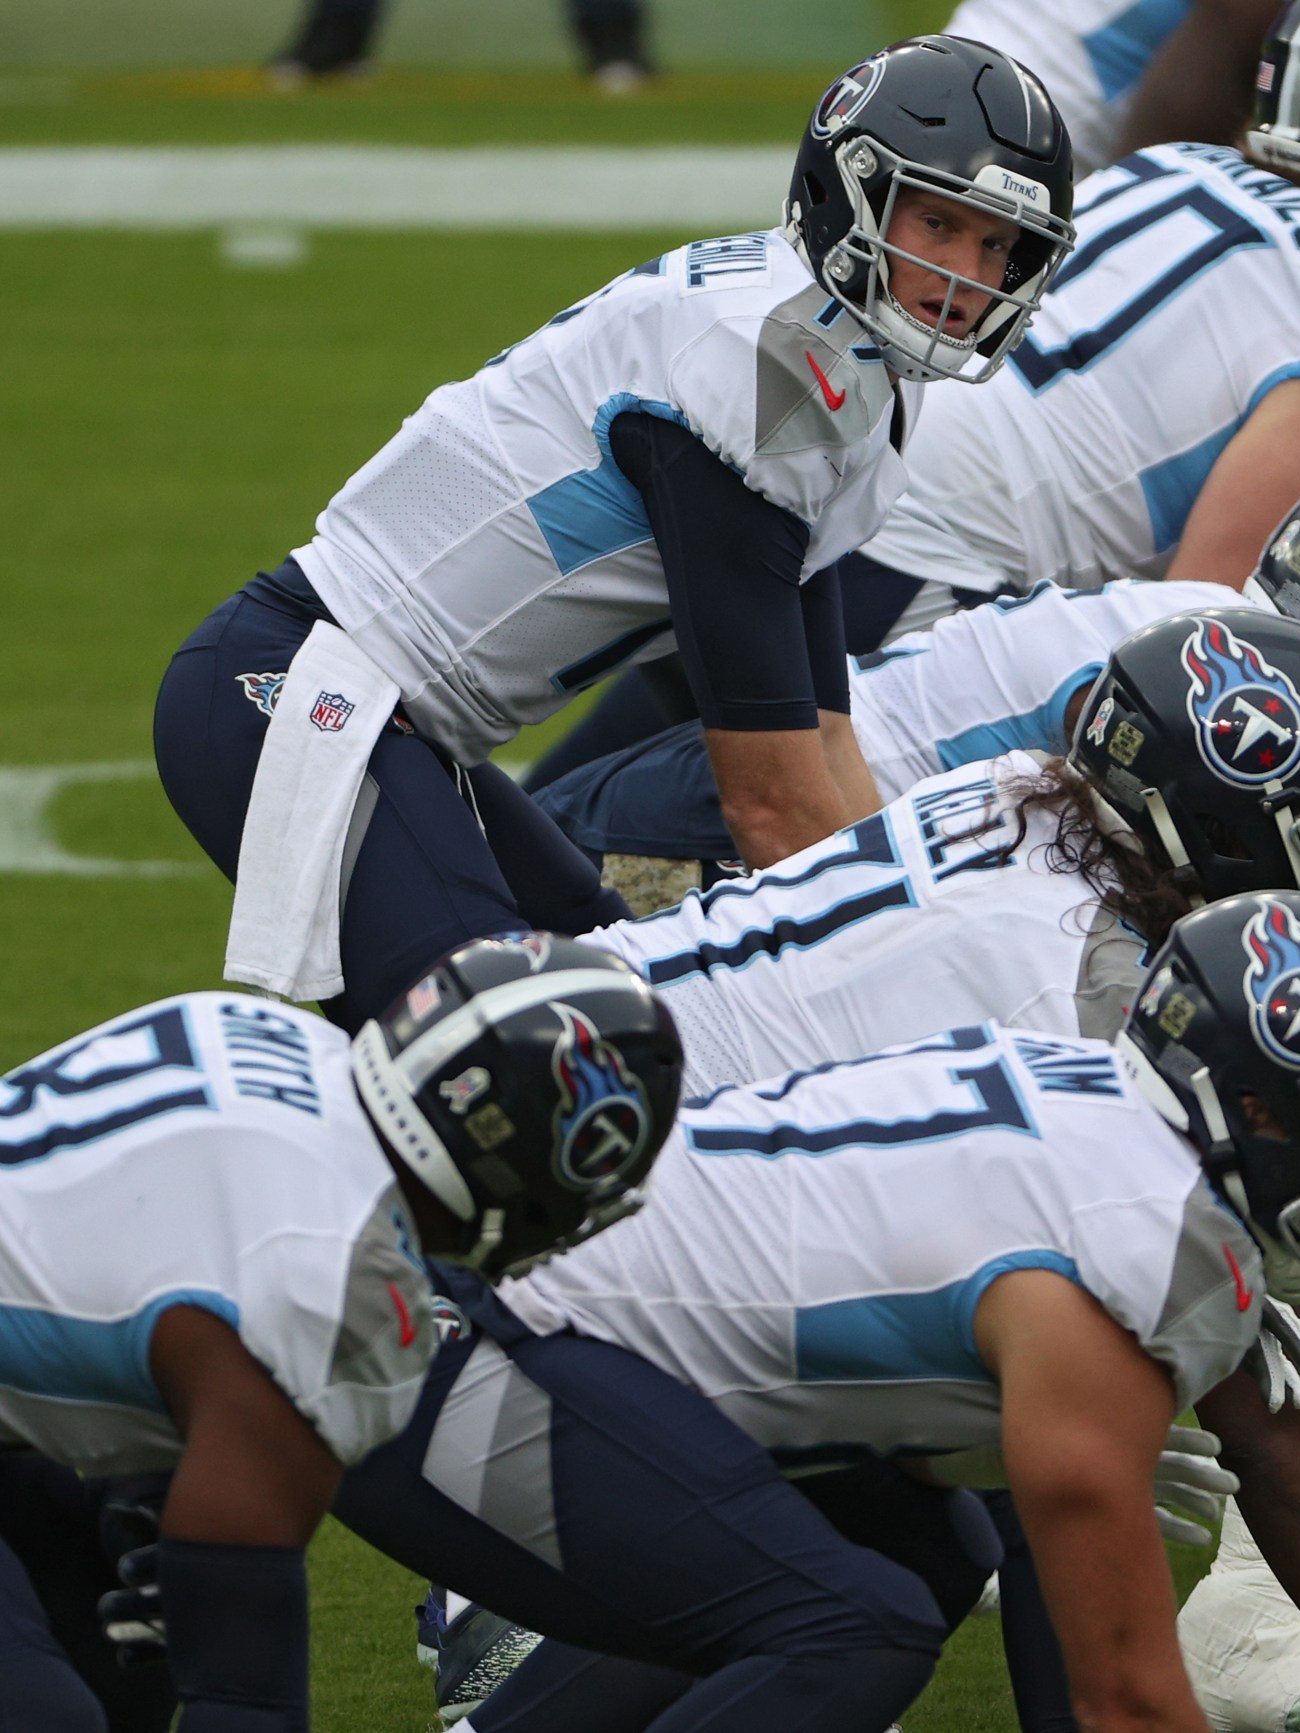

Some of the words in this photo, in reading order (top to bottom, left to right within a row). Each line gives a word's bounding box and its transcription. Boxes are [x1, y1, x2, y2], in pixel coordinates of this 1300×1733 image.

[311, 703, 343, 729] NFL
[912, 777, 1017, 885] KELLY
[219, 1002, 322, 1117] SMITH
